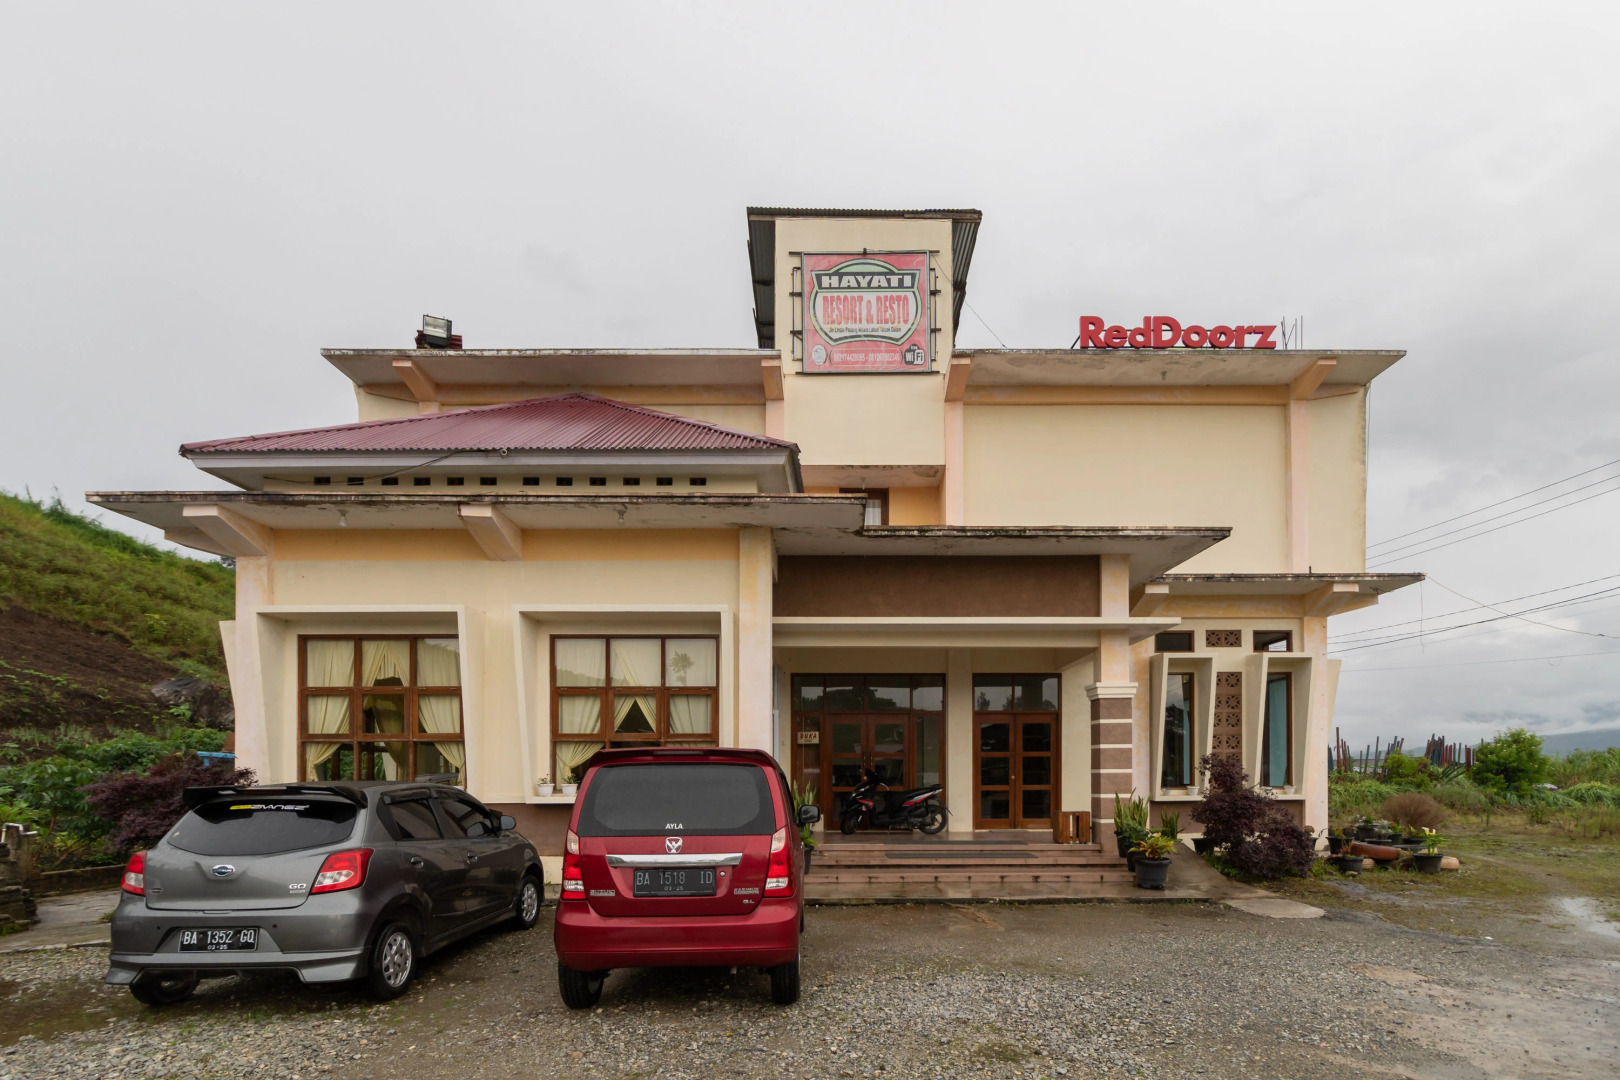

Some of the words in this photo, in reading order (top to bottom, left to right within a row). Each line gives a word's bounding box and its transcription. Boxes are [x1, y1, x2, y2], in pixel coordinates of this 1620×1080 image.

[821, 275, 912, 288] HAYATI
[822, 294, 864, 325] RESORT
[866, 299, 874, 325] &
[876, 294, 910, 325] RESTO
[1079, 315, 1277, 349] RedDoorz
[636, 872, 650, 885] BA
[659, 871, 686, 885] 1518
[183, 931, 197, 945] BA
[207, 930, 234, 944] 1352
